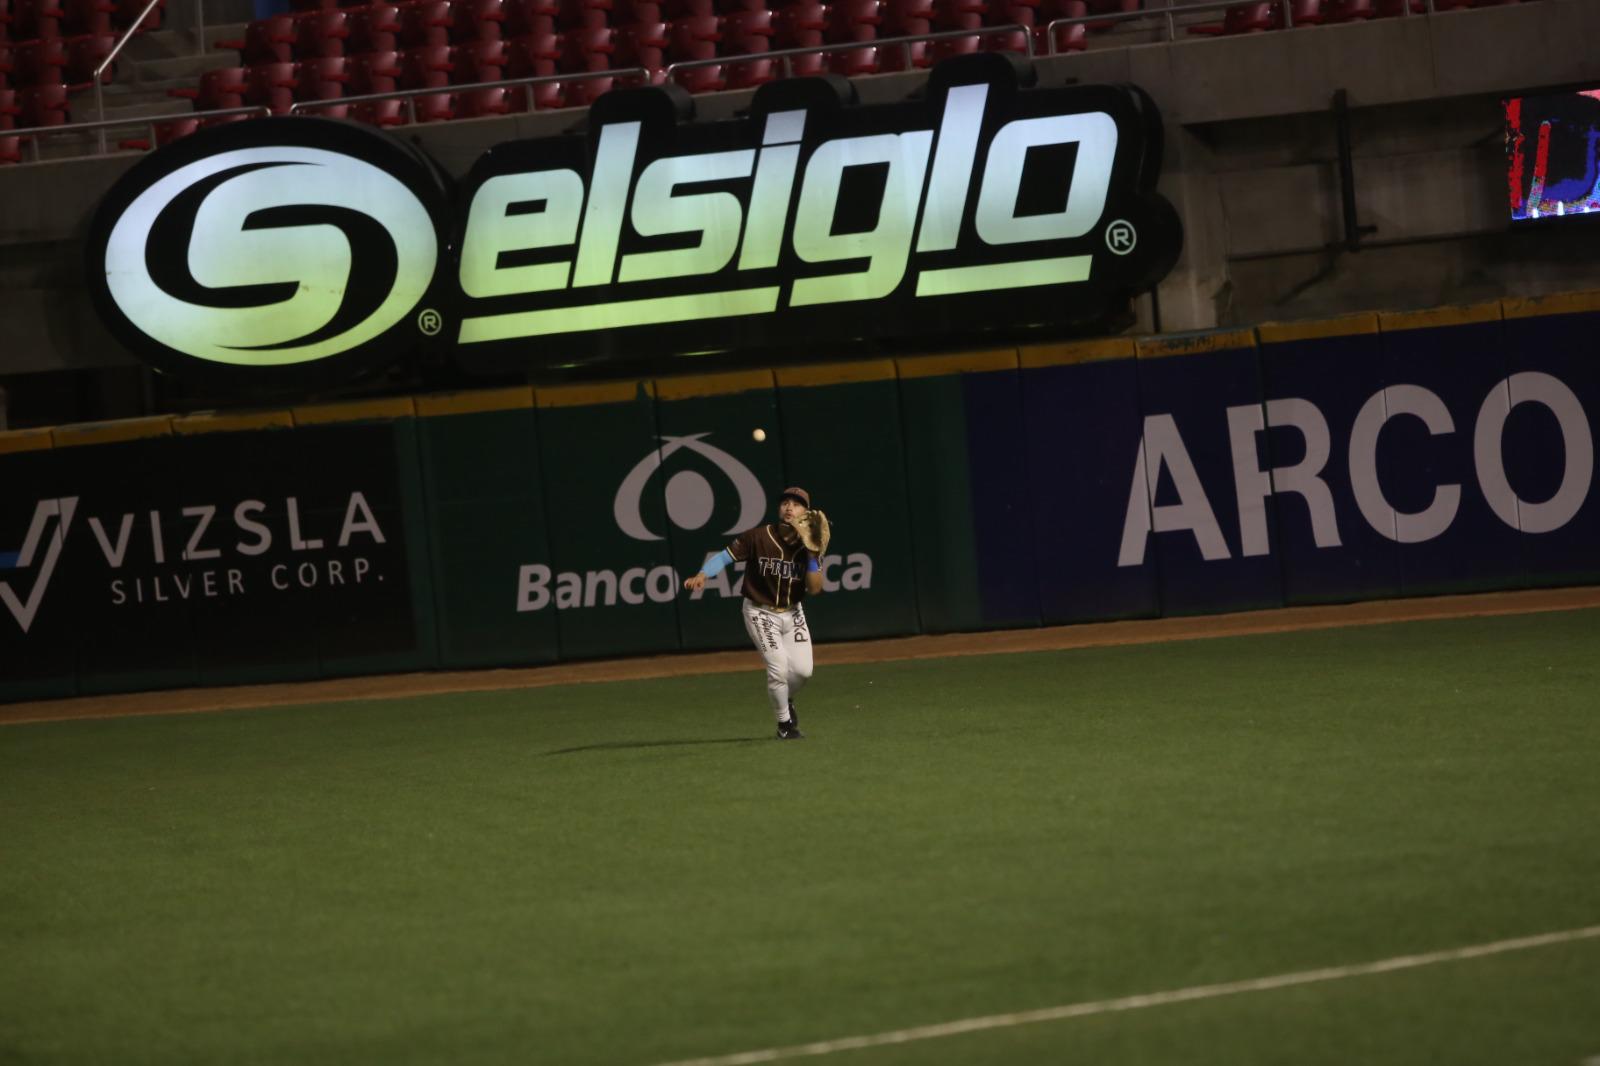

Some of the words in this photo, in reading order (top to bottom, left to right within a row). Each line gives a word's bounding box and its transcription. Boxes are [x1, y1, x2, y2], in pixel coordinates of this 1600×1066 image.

[458, 83, 1119, 308] elsiglo
[1117, 371, 1594, 567] ARCO
[88, 491, 386, 567] VIZSLA
[111, 569, 245, 604] SILVER
[271, 558, 384, 590] CORP.
[516, 563, 680, 612] Banco
[689, 551, 873, 601] Azca
